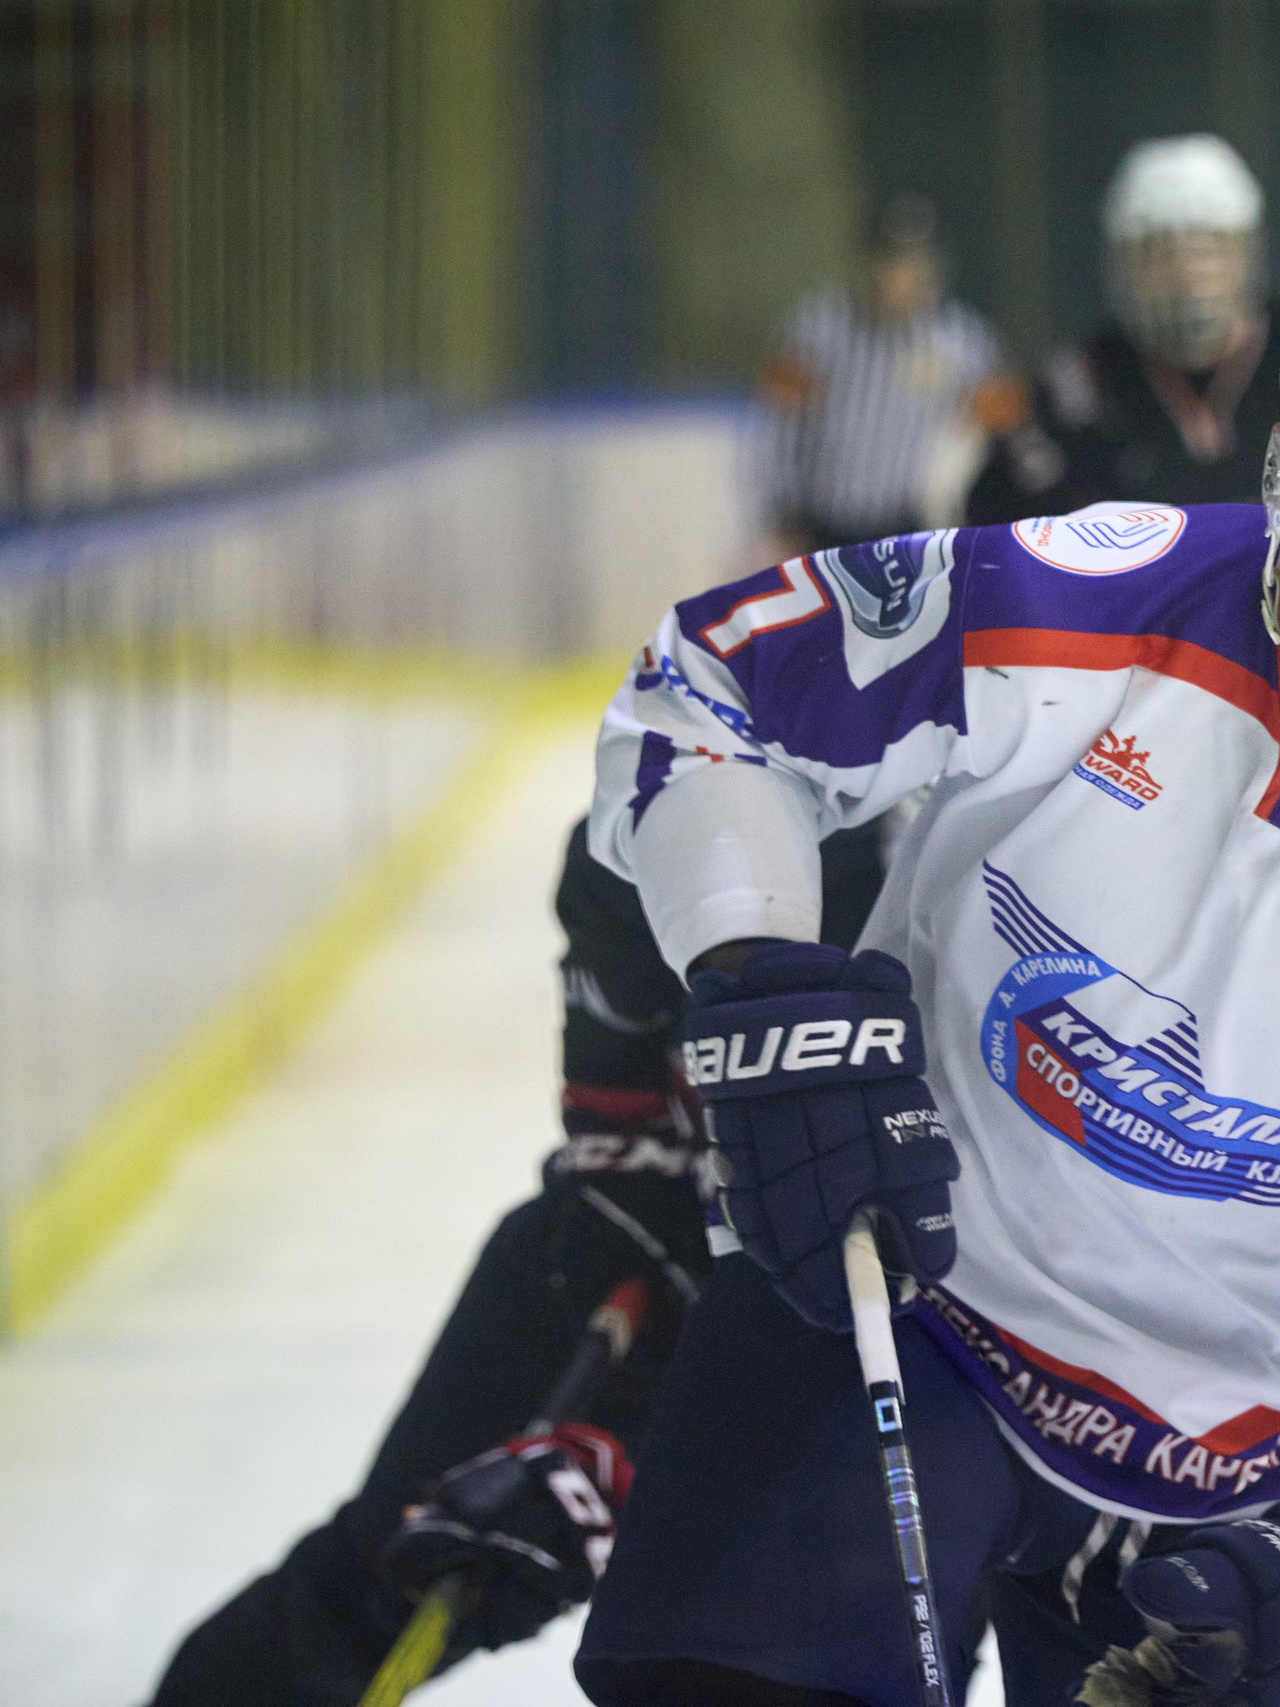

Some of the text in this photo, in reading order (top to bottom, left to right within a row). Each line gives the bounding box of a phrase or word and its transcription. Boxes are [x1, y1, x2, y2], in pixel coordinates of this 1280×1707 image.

[1084, 755, 1159, 801] WARD
[1010, 956, 1102, 987] КАРЕЛИНА
[1025, 1042, 1229, 1174] СПОРТИВНЫЙ
